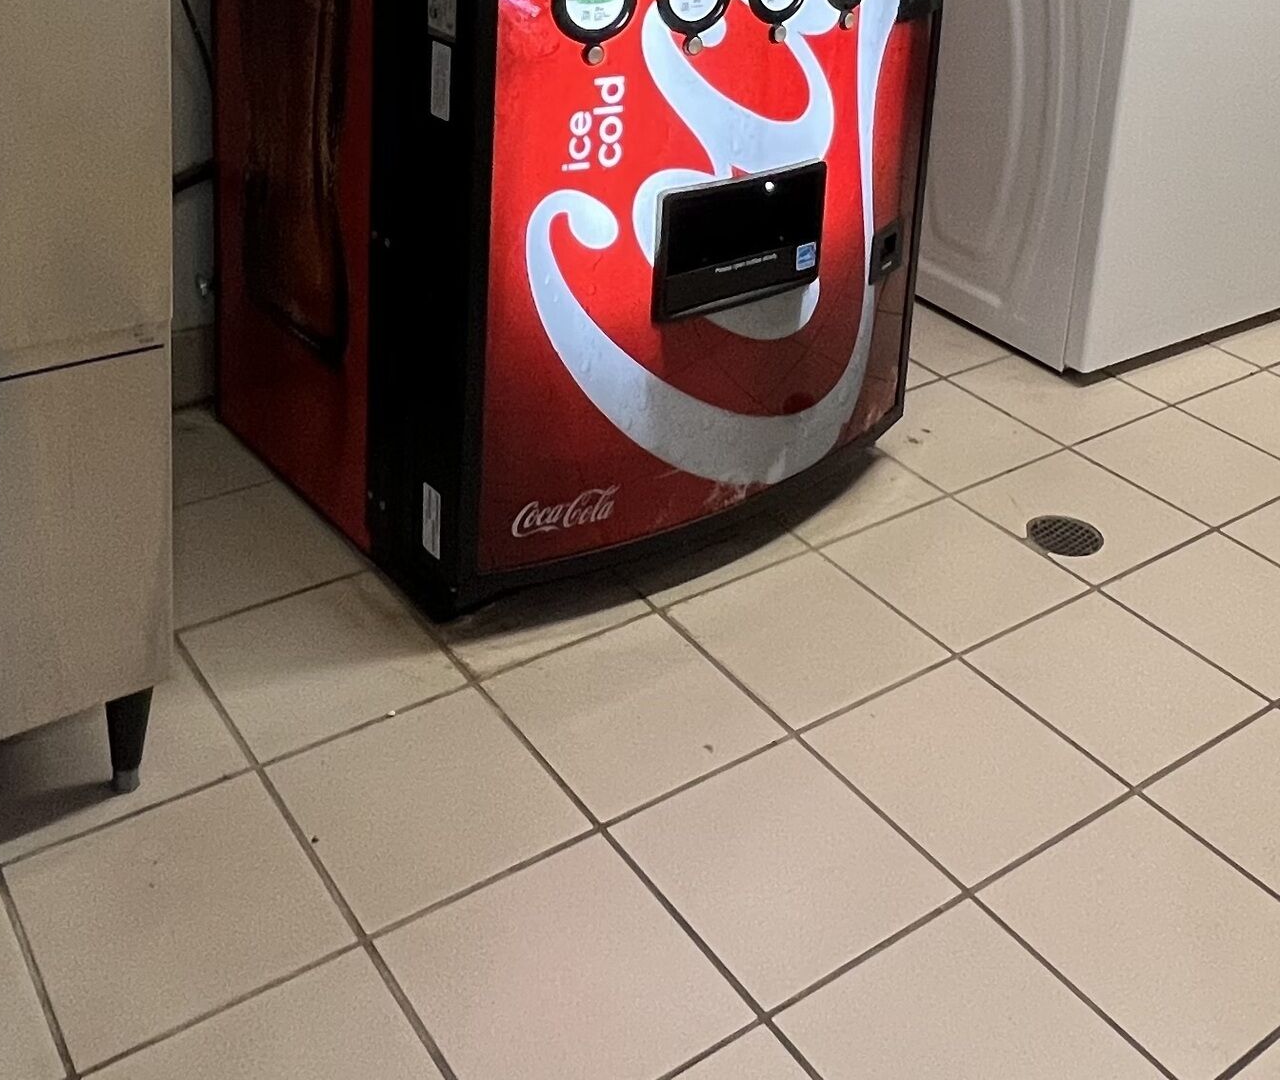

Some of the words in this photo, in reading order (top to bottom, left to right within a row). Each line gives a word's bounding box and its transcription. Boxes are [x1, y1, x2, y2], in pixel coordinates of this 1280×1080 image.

[561, 109, 593, 172] ice
[593, 75, 626, 169] cold
[511, 484, 621, 538] Coca-Cola
